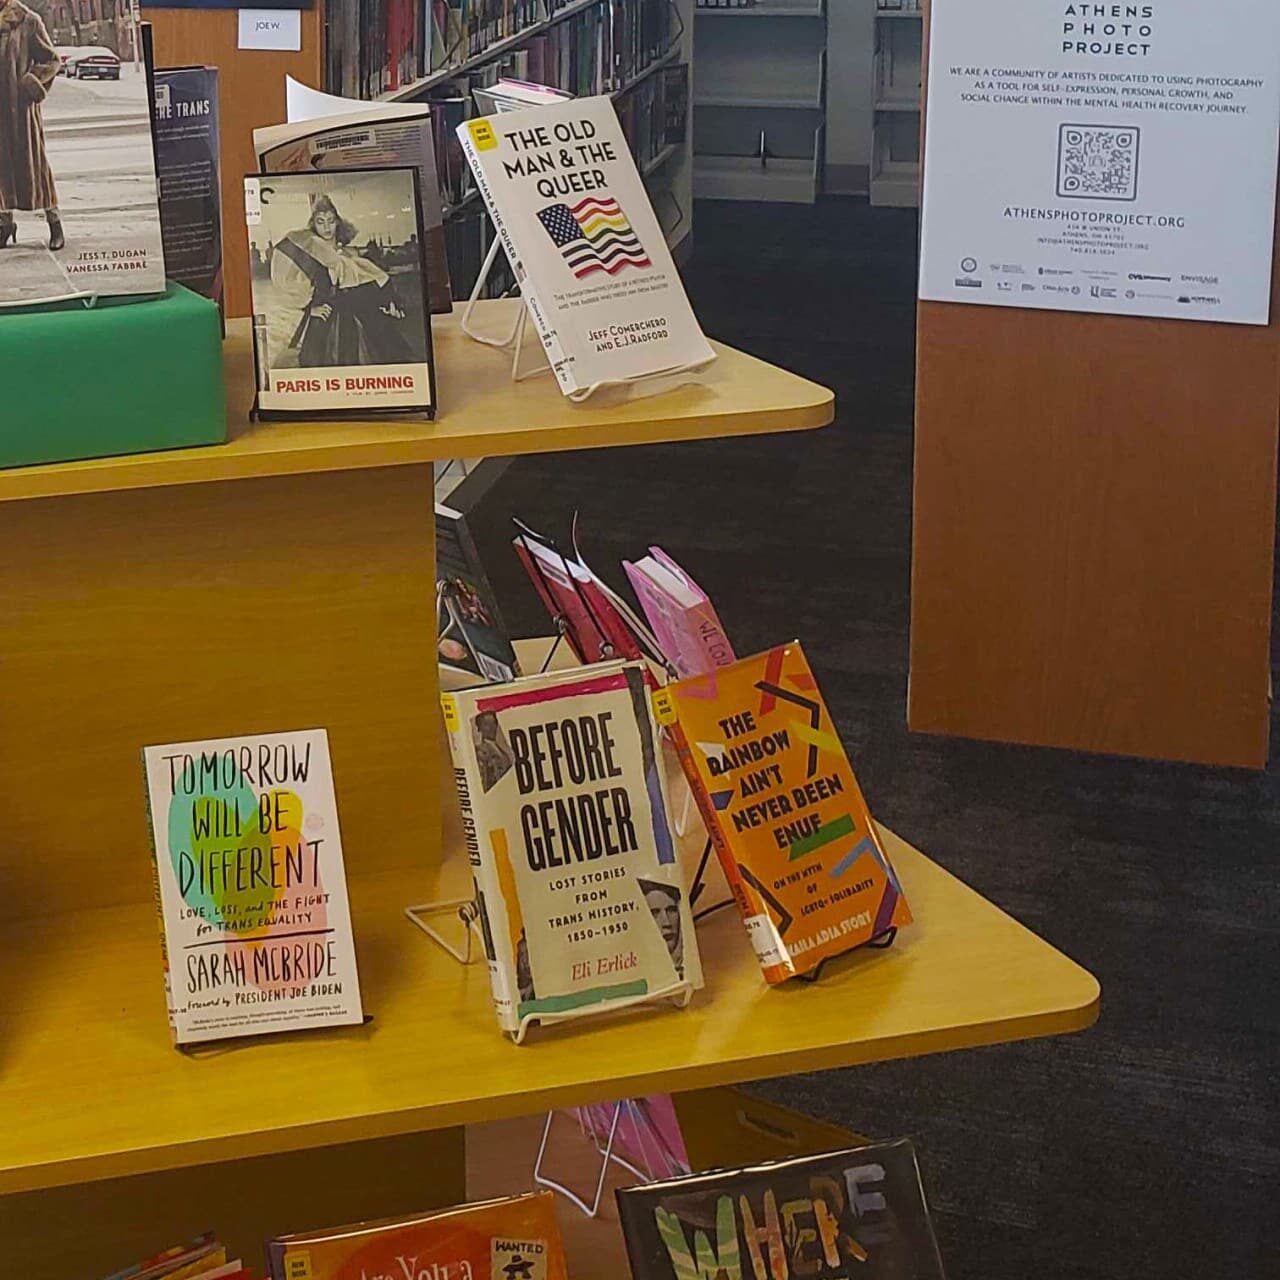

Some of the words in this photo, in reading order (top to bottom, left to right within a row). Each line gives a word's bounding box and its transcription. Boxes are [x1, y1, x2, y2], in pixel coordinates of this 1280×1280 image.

[1065, 4, 1154, 18] ATHENS
[256, 22, 270, 31] JOE
[1063, 22, 1151, 37] PHOTO
[1062, 40, 1151, 56] PROJECT
[950, 67, 962, 75] WE
[964, 68, 980, 76] ARE
[983, 68, 990, 76] A
[992, 68, 1044, 78] COMMUNITY
[1048, 70, 1058, 78] OF
[1062, 72, 1096, 80] ARTISTS
[1098, 73, 1149, 83] DEDICATED
[1152, 76, 1164, 84] TO
[1166, 76, 1193, 84] USING
[1196, 77, 1264, 88] PHOTOGRAPHY
[176, 100, 210, 118] TRANS
[960, 94, 990, 102] SOCIAL
[993, 94, 1029, 104] CHANGE
[1032, 96, 1062, 105] WITHIN
[1066, 98, 1081, 106] THE
[1084, 99, 1118, 108] MENTAL
[1122, 101, 1156, 110] HEALTH
[1158, 102, 1204, 112] RECOVERY
[504, 126, 554, 152] THE
[553, 120, 596, 144] OLD
[502, 154, 555, 180] MAN
[560, 152, 574, 168] &
[577, 141, 618, 164] THE
[537, 168, 608, 198] QUEER
[1004, 207, 1185, 228] ATHENSPHOTOPROJECT.ORG
[66, 263, 109, 274] VANESSA
[112, 260, 148, 272] FABBRE
[78, 250, 99, 261] JESS
[101, 250, 110, 260] T.
[112, 248, 148, 260] DUGAN
[588, 329, 608, 341] JEFF
[609, 318, 667, 337] COMERCHERO
[596, 340, 614, 353] AND
[276, 378, 321, 394] PARIS
[326, 377, 340, 391] IS
[345, 376, 414, 392] BURNING
[718, 710, 757, 740] THE
[508, 712, 622, 795] BEFORE
[706, 729, 791, 776] RAINBOW
[162, 742, 311, 797] TOMORROW
[738, 764, 784, 800] AIN'T
[192, 797, 242, 841] WILL
[259, 791, 290, 834] BE
[731, 794, 794, 833] NEVER
[794, 774, 844, 808] BEEN
[521, 787, 639, 872] GENDER
[772, 814, 824, 850] ENUF
[179, 839, 324, 899] DIFFERENT
[549, 877, 576, 892] LOST
[581, 867, 626, 886] STORIES
[180, 906, 212, 920] LOVE,
[214, 904, 243, 917] LOSS,
[245, 902, 264, 913] and
[266, 898, 289, 910] THE
[295, 894, 330, 908] FIGHT
[575, 890, 608, 904] FROM
[196, 922, 213, 937] for
[216, 918, 254, 932] TRANS
[258, 912, 312, 928] EQUALITY
[548, 914, 584, 929] TRANS
[588, 902, 640, 922] HISTORY,
[187, 952, 248, 995] SARAH
[252, 940, 337, 986] MCBRIDE
[572, 962, 594, 981] Eli
[597, 952, 640, 976] Erlick
[222, 996, 232, 1008] by
[235, 988, 288, 1006] PRESIDENT
[290, 986, 308, 1000] JOE
[311, 983, 343, 998] BIDEN
[654, 1163, 886, 1280] WHERE
[495, 1240, 544, 1254] WANTED
